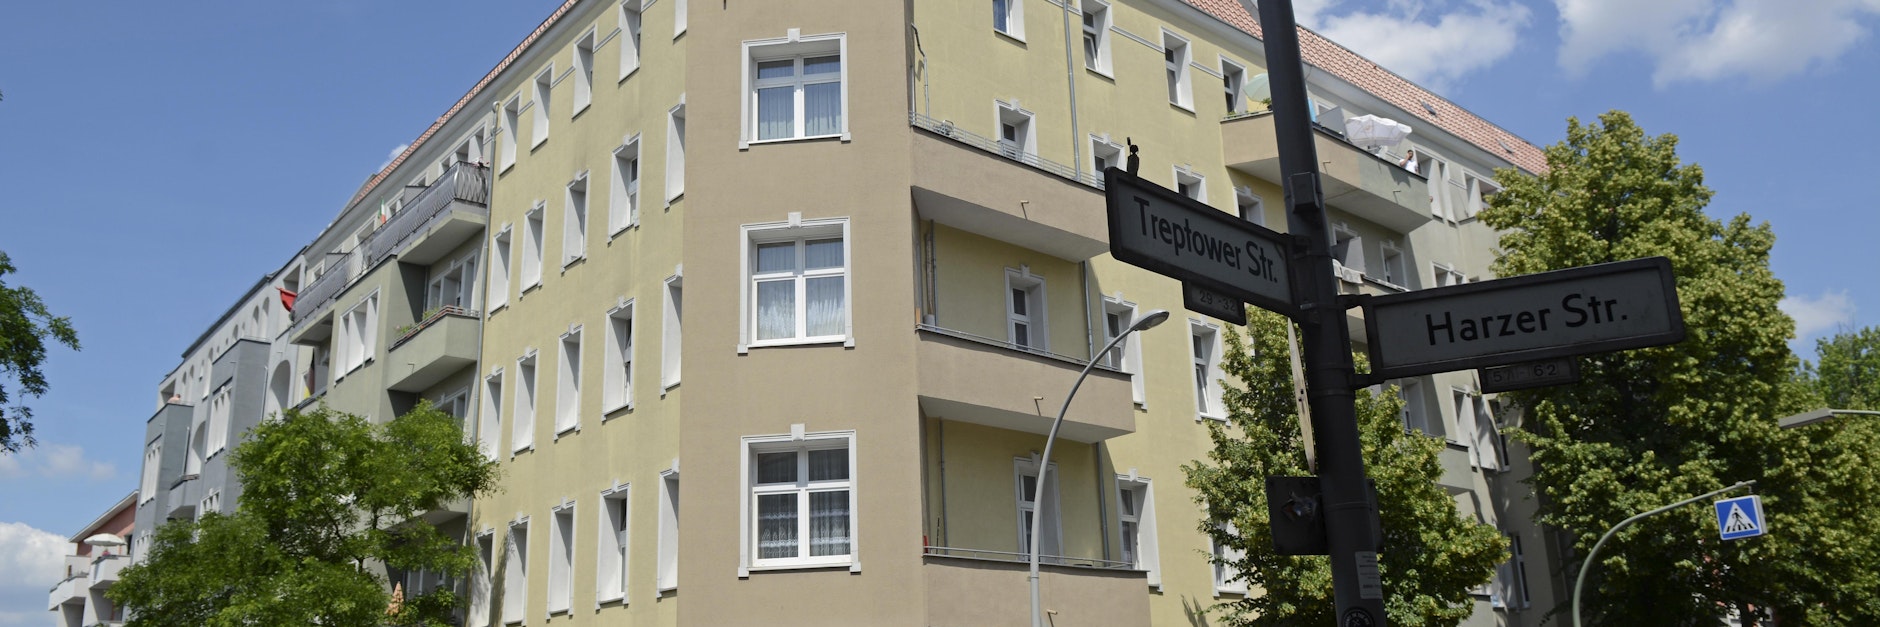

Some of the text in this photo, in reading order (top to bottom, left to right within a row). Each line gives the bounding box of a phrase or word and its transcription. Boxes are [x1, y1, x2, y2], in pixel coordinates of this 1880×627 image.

[1133, 196, 1279, 284] Treptower Str.
[1425, 293, 1628, 346] Harzer Str.
[1533, 363, 1557, 377] 62
